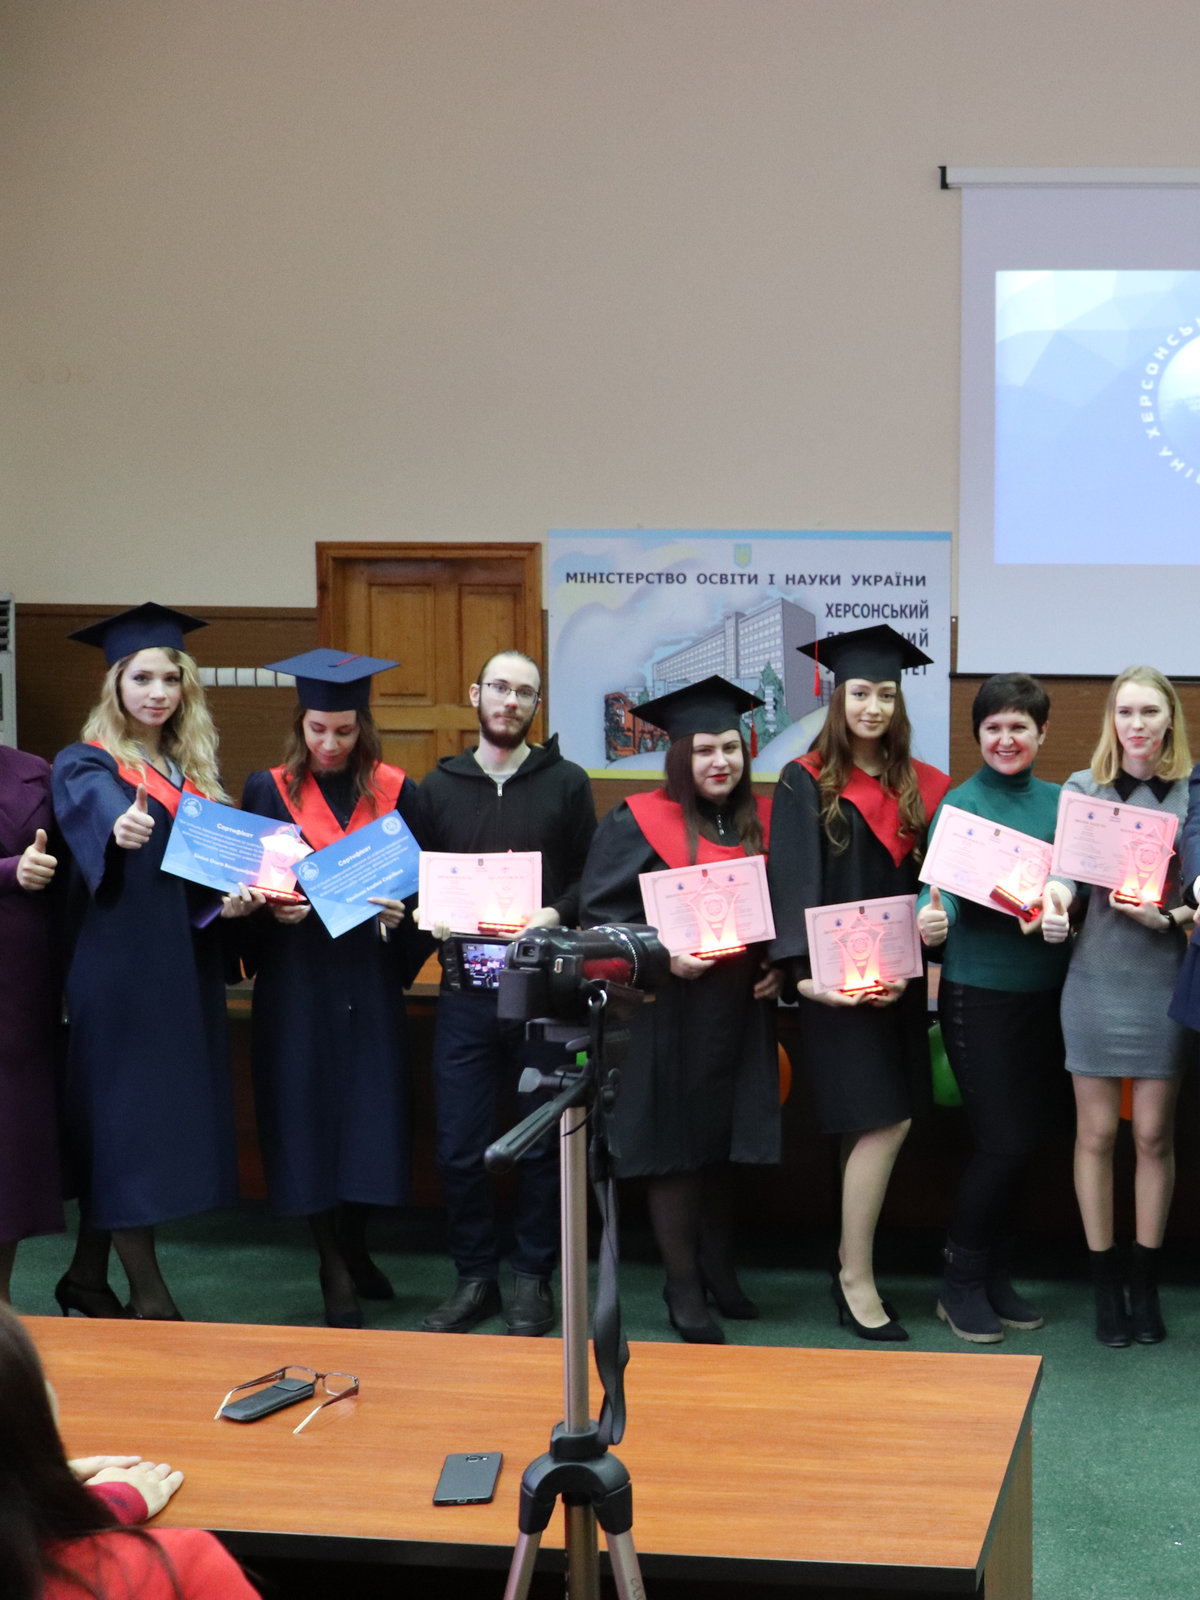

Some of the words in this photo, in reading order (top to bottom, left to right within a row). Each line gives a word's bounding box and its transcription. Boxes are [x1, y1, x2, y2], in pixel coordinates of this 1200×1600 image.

[565, 571, 687, 585] МІНІСТЕРСТВО
[696, 572, 759, 586] ОСВІТИ
[768, 573, 776, 586] І
[785, 573, 841, 586] НАУКИ
[851, 571, 927, 587] УКРАЇНИ
[825, 599, 930, 619] ХЕРСОНСЬКИЙ
